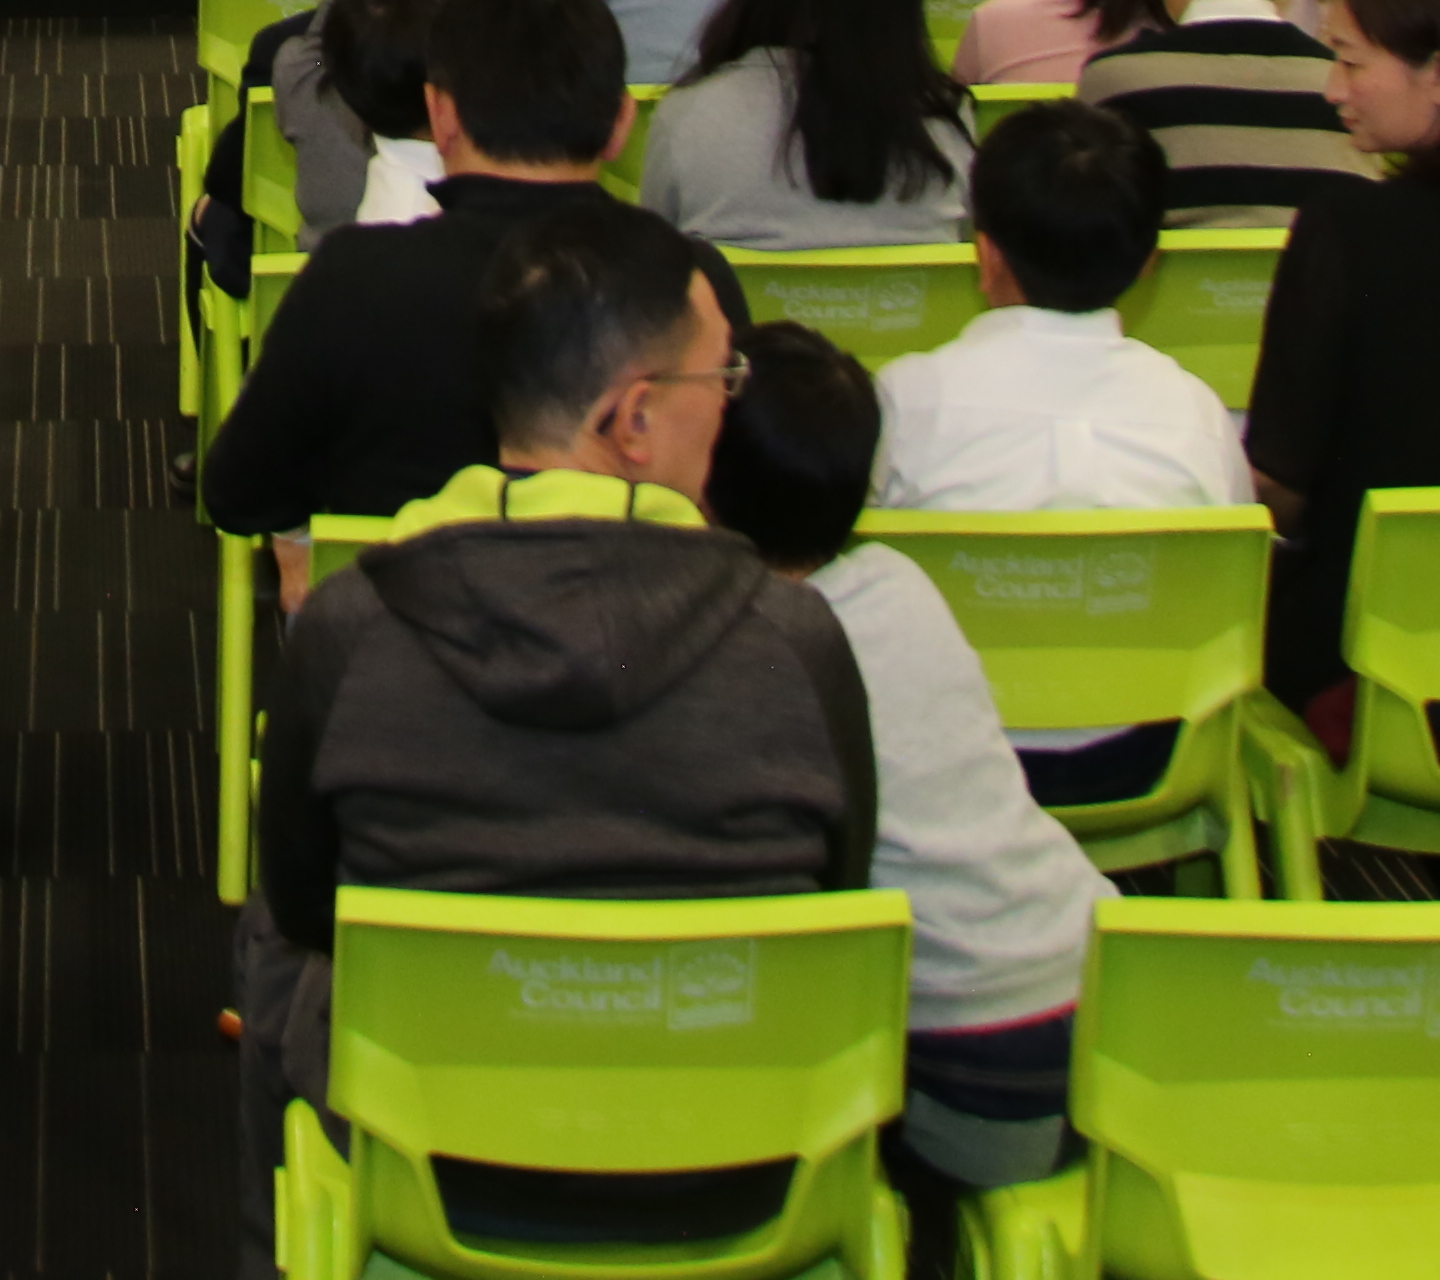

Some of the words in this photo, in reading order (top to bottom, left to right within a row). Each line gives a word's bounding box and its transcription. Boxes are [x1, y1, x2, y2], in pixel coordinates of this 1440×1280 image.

[974, 574, 1083, 600] Council
[487, 948, 661, 983] Auckland
[520, 978, 662, 1011] Council
[1279, 988, 1423, 1019] Council
